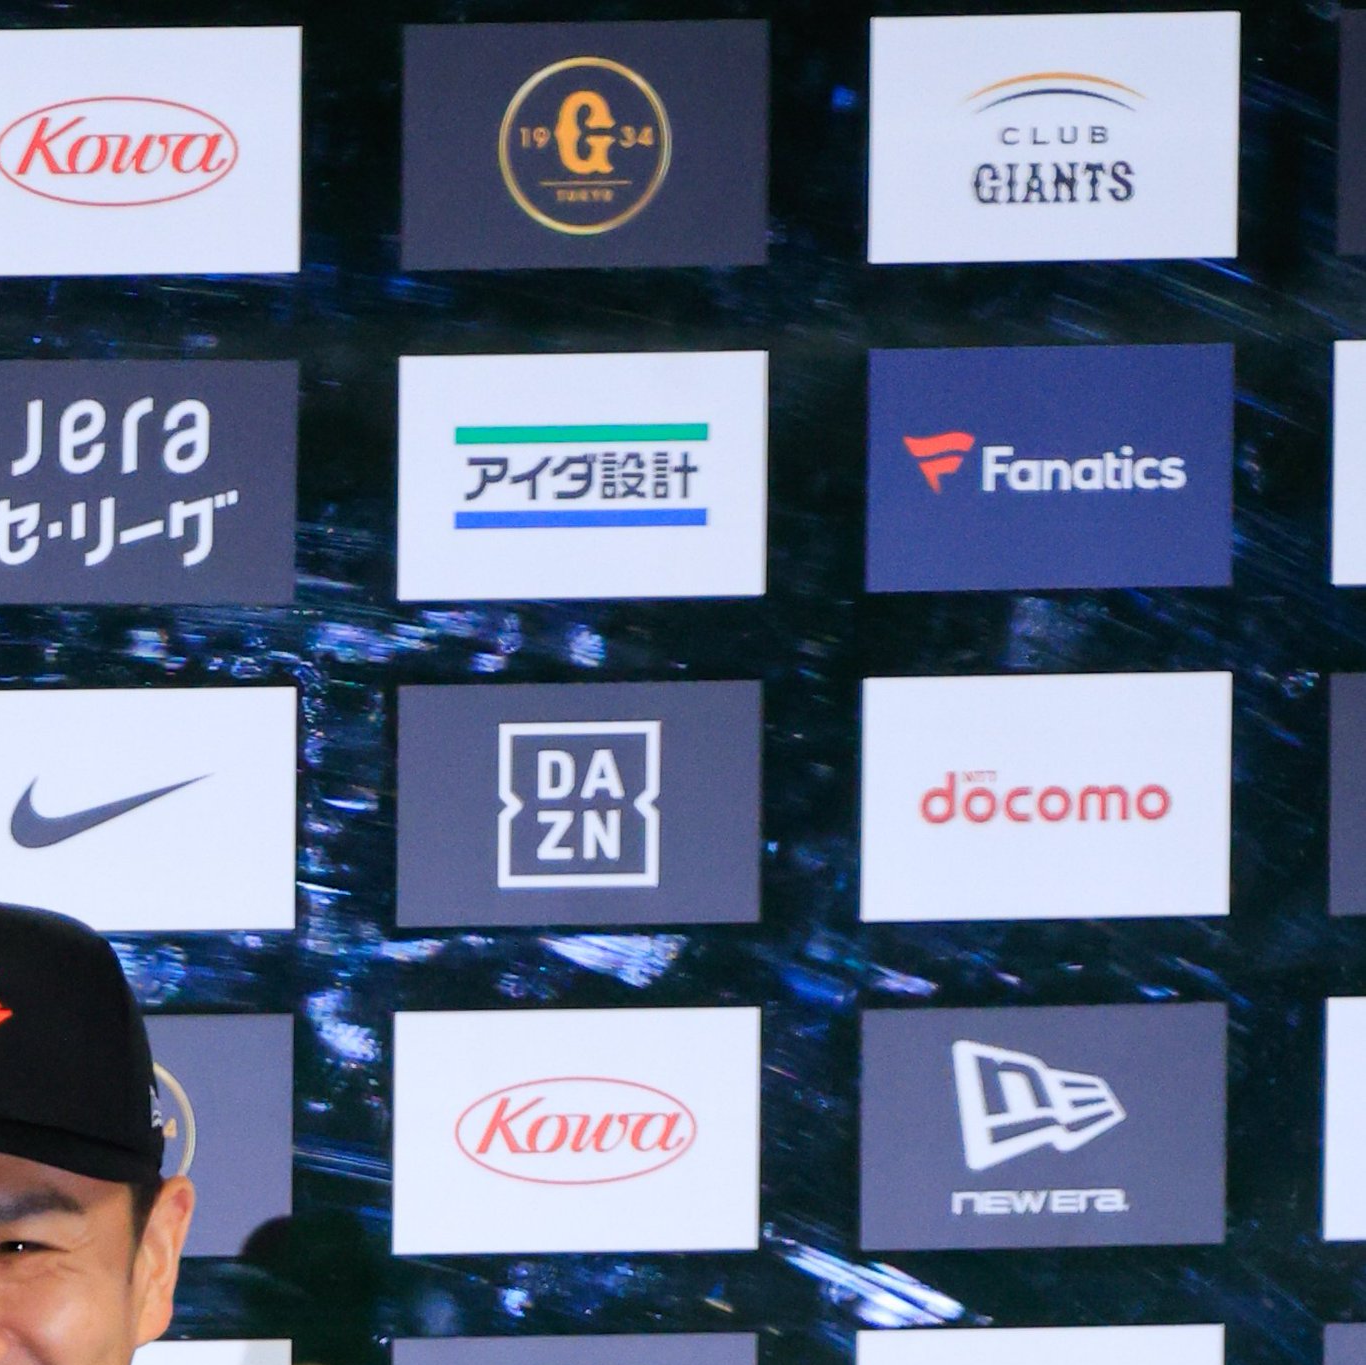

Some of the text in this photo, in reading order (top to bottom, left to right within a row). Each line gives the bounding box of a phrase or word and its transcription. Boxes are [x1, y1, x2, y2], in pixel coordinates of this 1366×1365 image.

[16, 116, 227, 176] Kowa
[521, 127, 550, 148] 19
[620, 126, 653, 147] 34
[1001, 126, 1108, 145] CLUB
[974, 161, 1133, 204] GIANTS
[465, 452, 698, 500] アイダ設計
[983, 446, 1186, 491] Fanatics
[538, 750, 624, 800] DA
[920, 772, 1171, 824] docomo
[537, 810, 620, 860] ZN
[476, 1095, 686, 1156] Kowa
